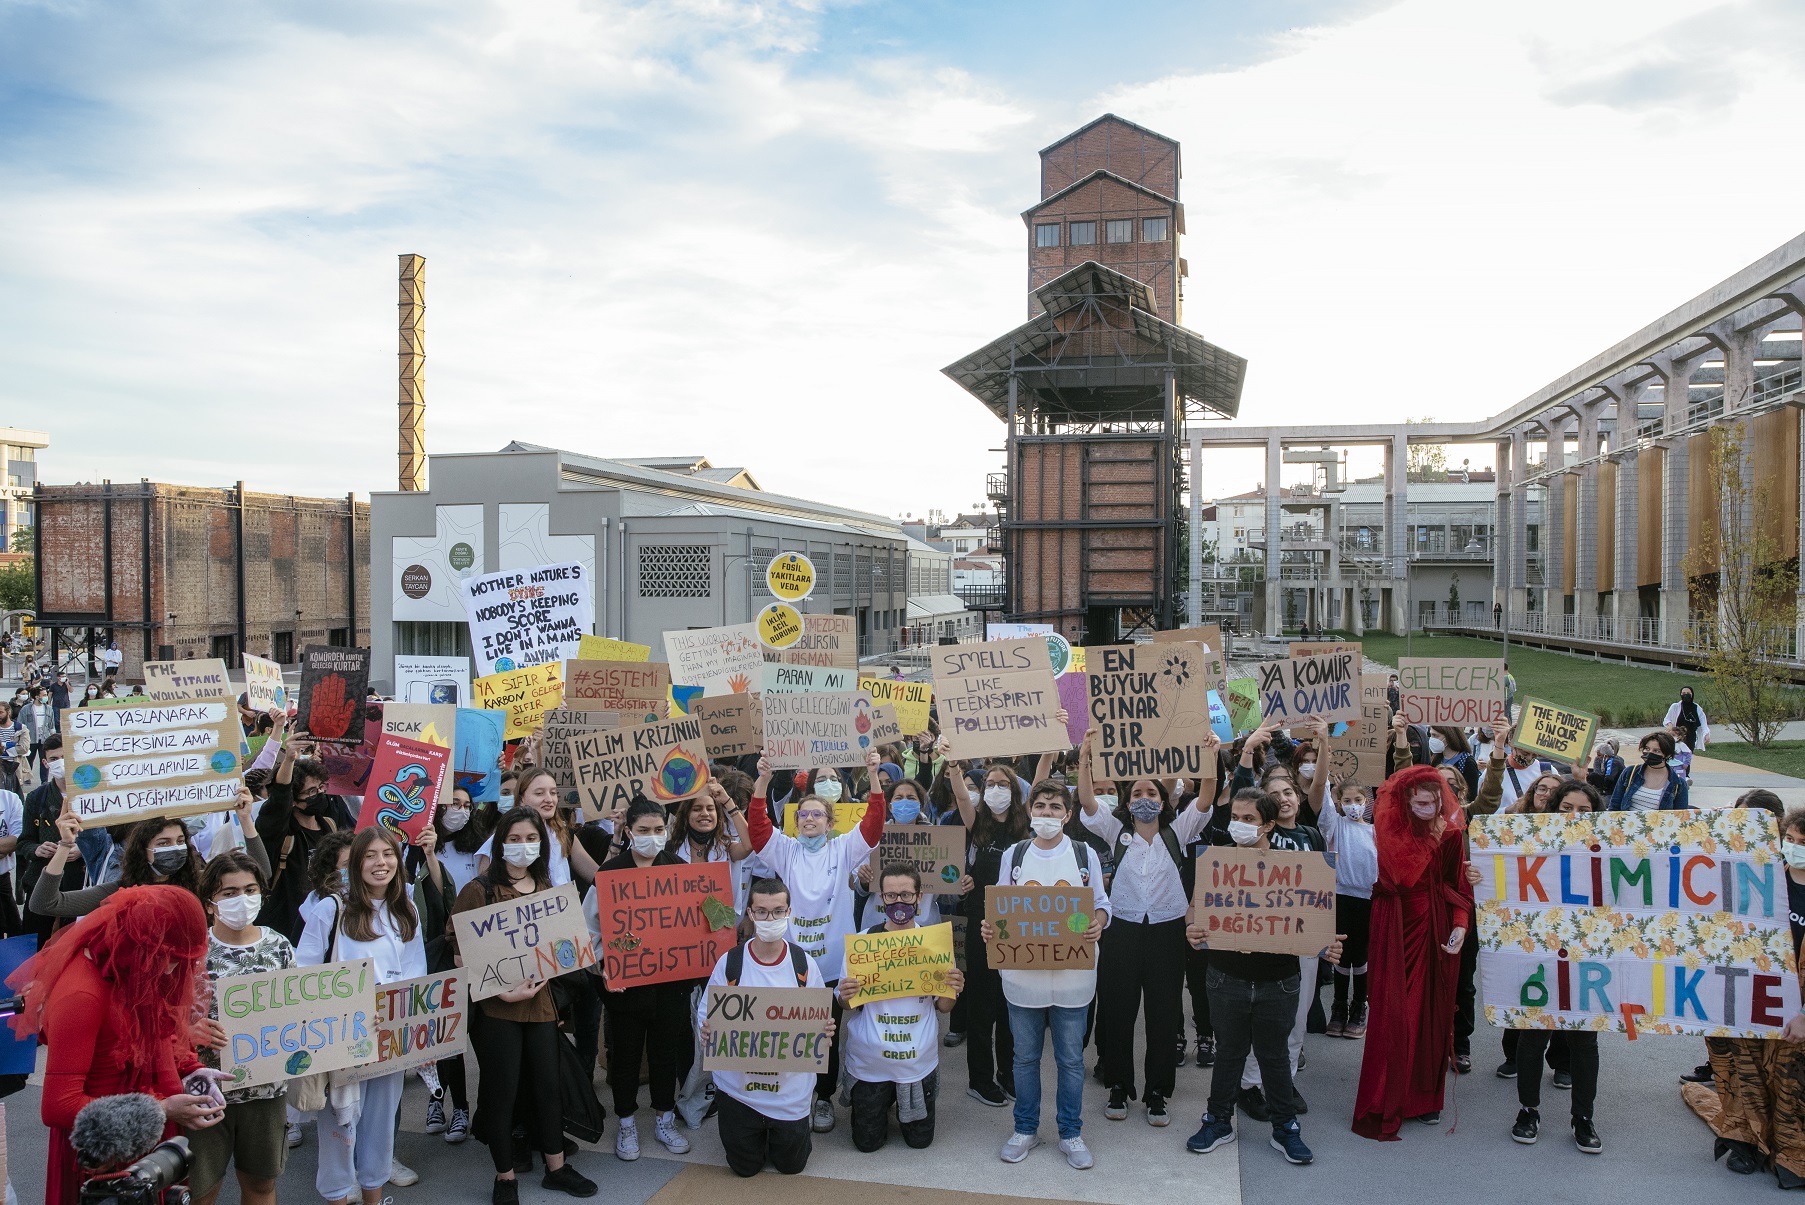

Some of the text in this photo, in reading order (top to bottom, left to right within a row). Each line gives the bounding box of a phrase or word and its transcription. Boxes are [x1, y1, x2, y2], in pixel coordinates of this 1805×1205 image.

[771, 571, 811, 583] YAKITLARA
[782, 562, 802, 573] FOSİL
[470, 566, 581, 596] MOTHER NATURE'S
[780, 582, 799, 591] VEDA
[475, 592, 579, 622] NOBODY'S KEEPING
[507, 610, 551, 630] SCORE
[766, 611, 786, 627] İKLİM
[772, 620, 788, 632] ACİL
[482, 616, 576, 649] I DON'T WANNA
[670, 631, 743, 650] THIS WORLD IS
[769, 624, 799, 644] DURUMU
[309, 652, 345, 662] KÖMÜRDEN
[486, 643, 513, 661] LIVE
[520, 637, 534, 650] IN
[537, 636, 546, 646] A
[679, 647, 718, 662] GETTING
[145, 663, 177, 677] THE
[333, 661, 361, 672] KURTAR
[681, 650, 761, 674] THAN MY IMAGINARY
[943, 646, 1031, 675] SMELLS
[172, 674, 222, 687] TITANIC
[573, 669, 658, 688] #SİSTEMİ
[776, 668, 844, 688] PARAN MI
[1259, 655, 1352, 691] YA KÖMÜR
[1400, 666, 1500, 691] GELECEK
[195, 688, 224, 698] HAVE
[475, 674, 539, 696] YA SIFIR
[575, 684, 625, 699] KÖKTEN
[862, 680, 926, 702] SON 11 YIL
[964, 677, 1003, 693] LIKE
[1090, 672, 1158, 697] BÜYÜK
[484, 691, 525, 709] KARBON
[512, 699, 544, 715] SIFIR
[764, 696, 787, 716] BEN
[1091, 695, 1160, 723] ÇINAR
[1263, 690, 1288, 718] YA
[1293, 682, 1351, 714] ÖMÜR
[1400, 693, 1505, 724] İSTİYORUZ
[76, 707, 210, 729] SİZ YAŞLANARAK
[513, 712, 544, 727] GELEC
[694, 705, 743, 720] PLANET
[1531, 705, 1588, 731] THE FUTURE
[386, 721, 423, 733] SICAK
[766, 718, 848, 738] DÜŞÜNMEKTEN
[954, 713, 1048, 735] POLLUTION
[182, 732, 212, 747] AMA
[575, 719, 702, 760] İKLİM KRİZİNİN
[1102, 721, 1145, 749] BİR
[1535, 732, 1569, 752] HANDS
[1557, 726, 1578, 743] OUR
[705, 743, 746, 756] ROFIT
[767, 738, 806, 758] BIKTIM
[578, 752, 658, 784] FARKINA
[80, 795, 122, 815] İKLİM
[588, 779, 644, 813] VAR
[879, 831, 932, 846] BİNALARI
[1212, 860, 1303, 889] İKLİMİ
[611, 873, 723, 904] İKLİMİ DEĞİL
[996, 895, 1081, 915] UPROOT
[1265, 888, 1334, 911] SİSTEMİ
[470, 895, 569, 938] WE NEED
[612, 901, 701, 935] SİSTEMİ
[793, 914, 832, 928] KÜRESEL
[1208, 912, 1305, 936] DEĞİŞTİR
[504, 922, 540, 949] TO
[797, 931, 825, 943] İKLİM
[1017, 921, 1060, 937] THE
[808, 944, 827, 958] REVİ
[853, 934, 924, 953] OLMAYAN
[996, 943, 1089, 964] SYSTEM
[606, 940, 718, 981] DEĞİŞTİR
[856, 972, 882, 987] BİR
[859, 979, 915, 998] NESİLİZ
[706, 992, 830, 1021] YOK OLMADAN
[877, 1013, 920, 1025] KÜRESEL
[883, 1030, 912, 1043] İKLİM
[705, 1030, 828, 1065] HAREKETE GEÇ
[883, 1046, 916, 1060] GREVİ
[746, 1081, 779, 1093] GREVİ
